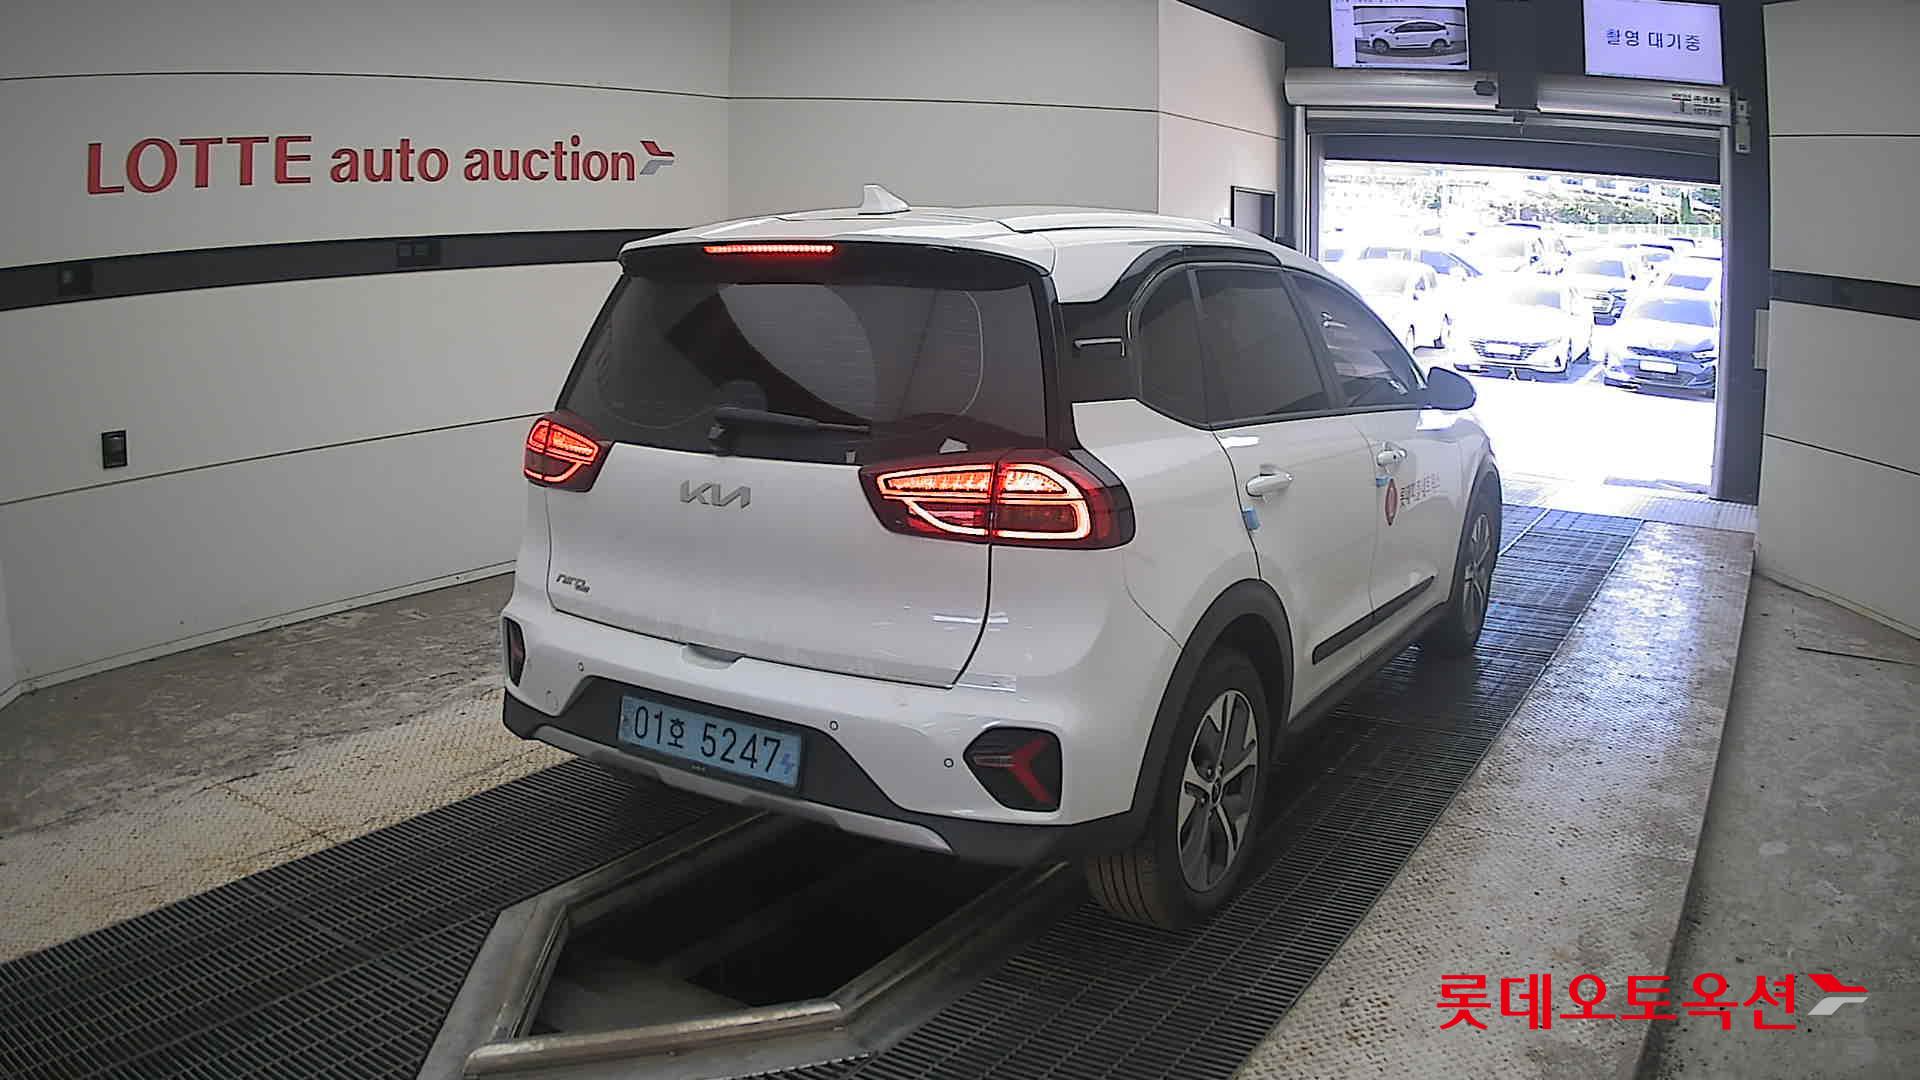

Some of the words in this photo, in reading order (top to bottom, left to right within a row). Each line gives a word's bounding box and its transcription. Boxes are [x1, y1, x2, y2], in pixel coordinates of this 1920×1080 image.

[1607, 29, 1639, 47] 촬영
[1648, 32, 1701, 51] 대기중
[87, 136, 312, 195] LOTTE
[329, 138, 448, 183] auto
[463, 134, 636, 182] auction
[680, 480, 751, 508] KIA
[633, 705, 685, 748] 01호
[700, 722, 781, 773] 5247
